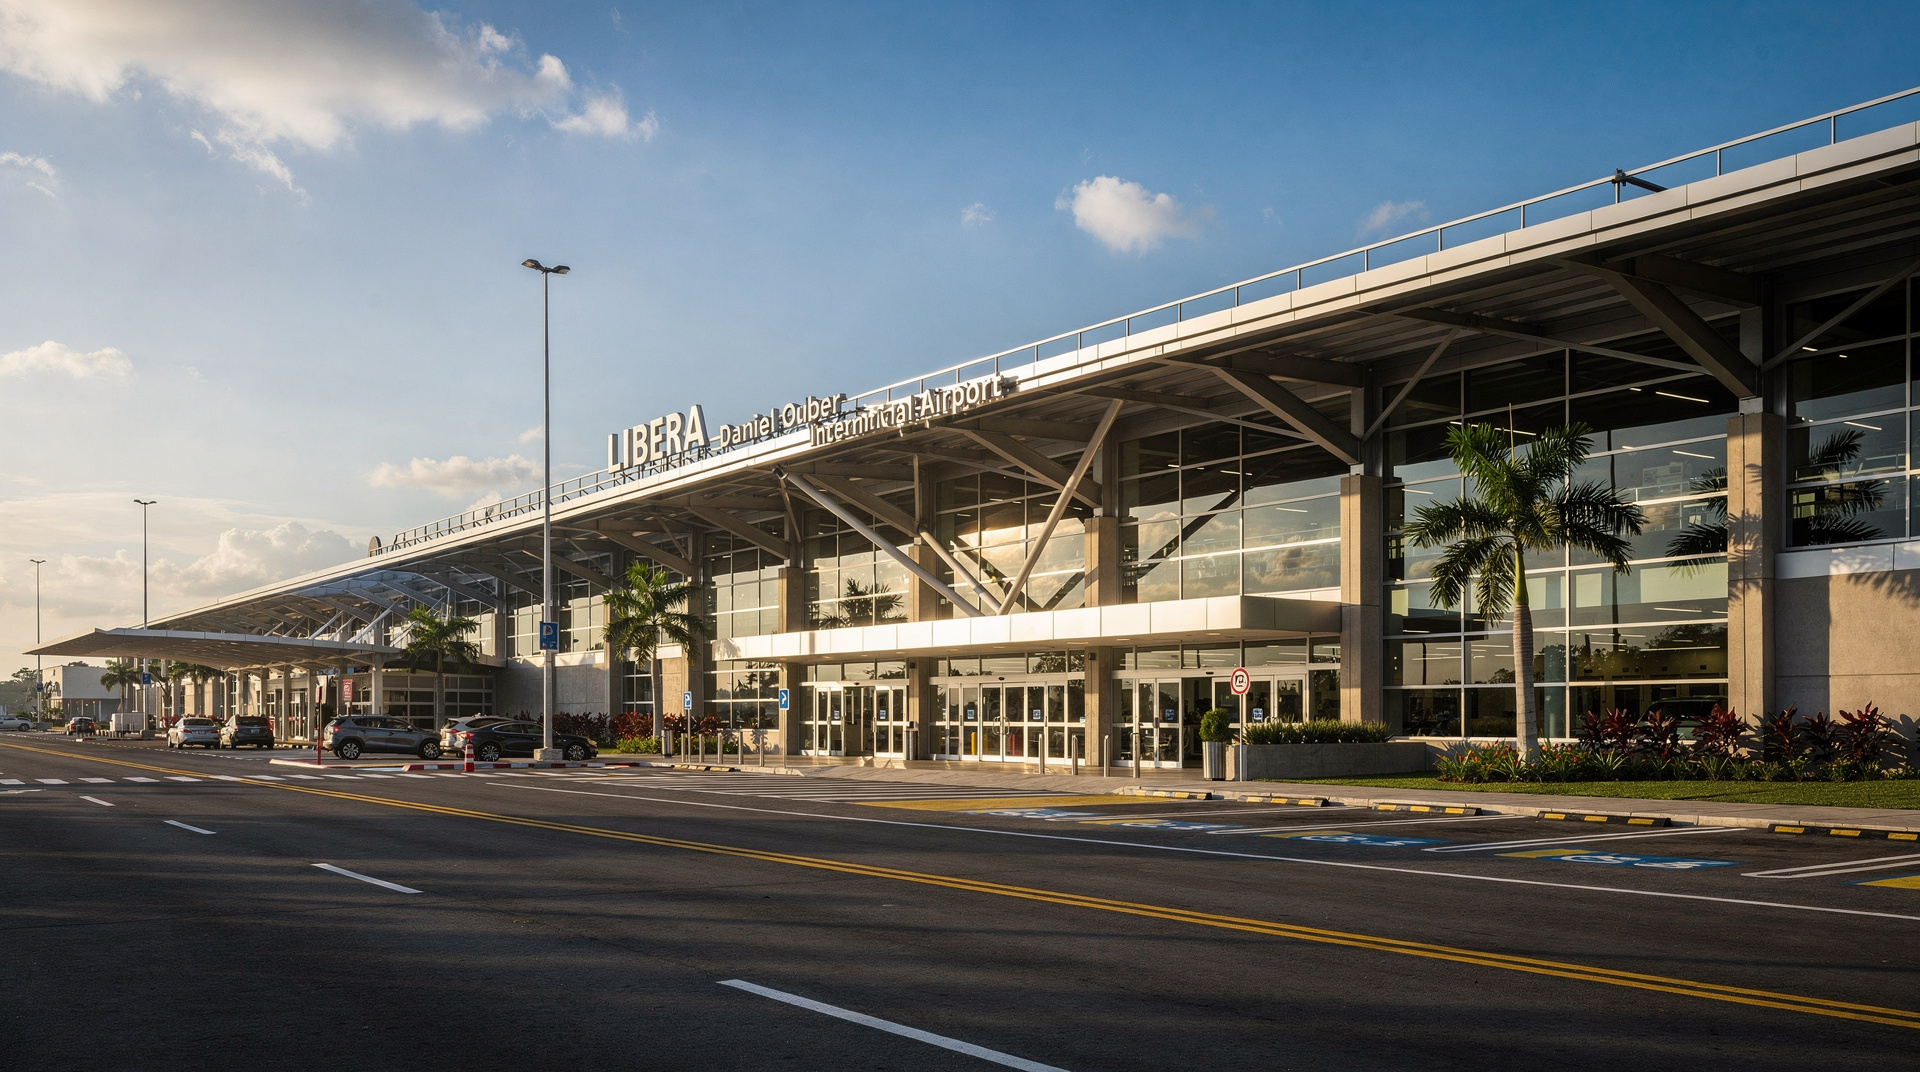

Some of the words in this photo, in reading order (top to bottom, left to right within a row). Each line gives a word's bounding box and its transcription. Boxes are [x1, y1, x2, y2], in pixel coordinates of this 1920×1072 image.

[920, 375, 1004, 414] Airport
[608, 404, 708, 474] LIBERA
[720, 408, 778, 447] Daniel
